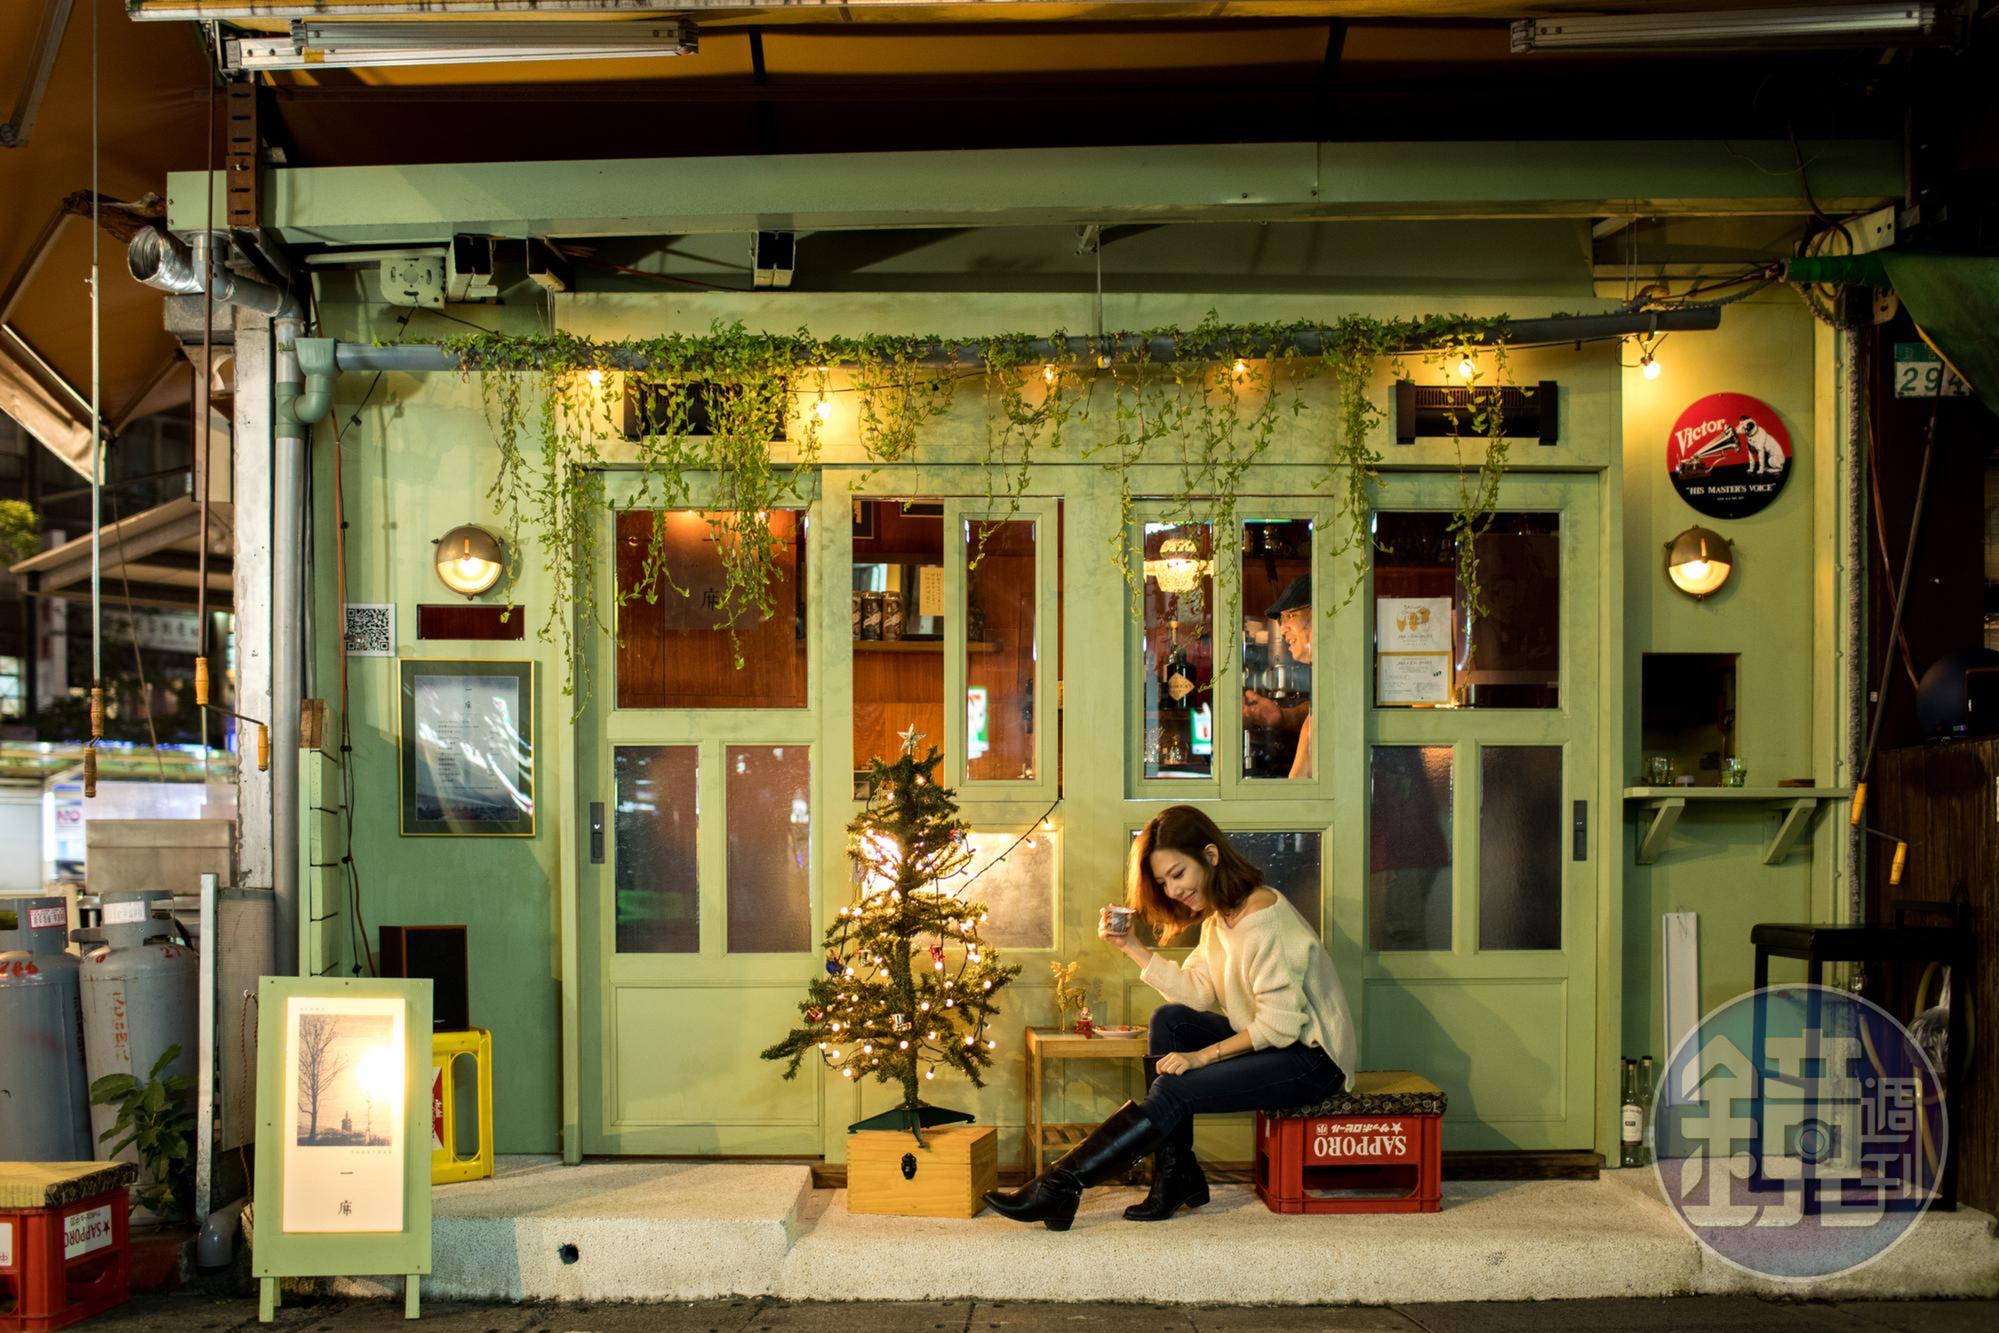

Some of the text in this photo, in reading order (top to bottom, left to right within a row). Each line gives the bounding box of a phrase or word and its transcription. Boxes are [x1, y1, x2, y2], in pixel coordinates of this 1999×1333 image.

[1675, 418, 1726, 457] Victor
[1708, 484, 1747, 494] MASTER'S
[1331, 1124, 1390, 1133] サッポロビール
[1313, 1136, 1406, 1156] SAPPORO
